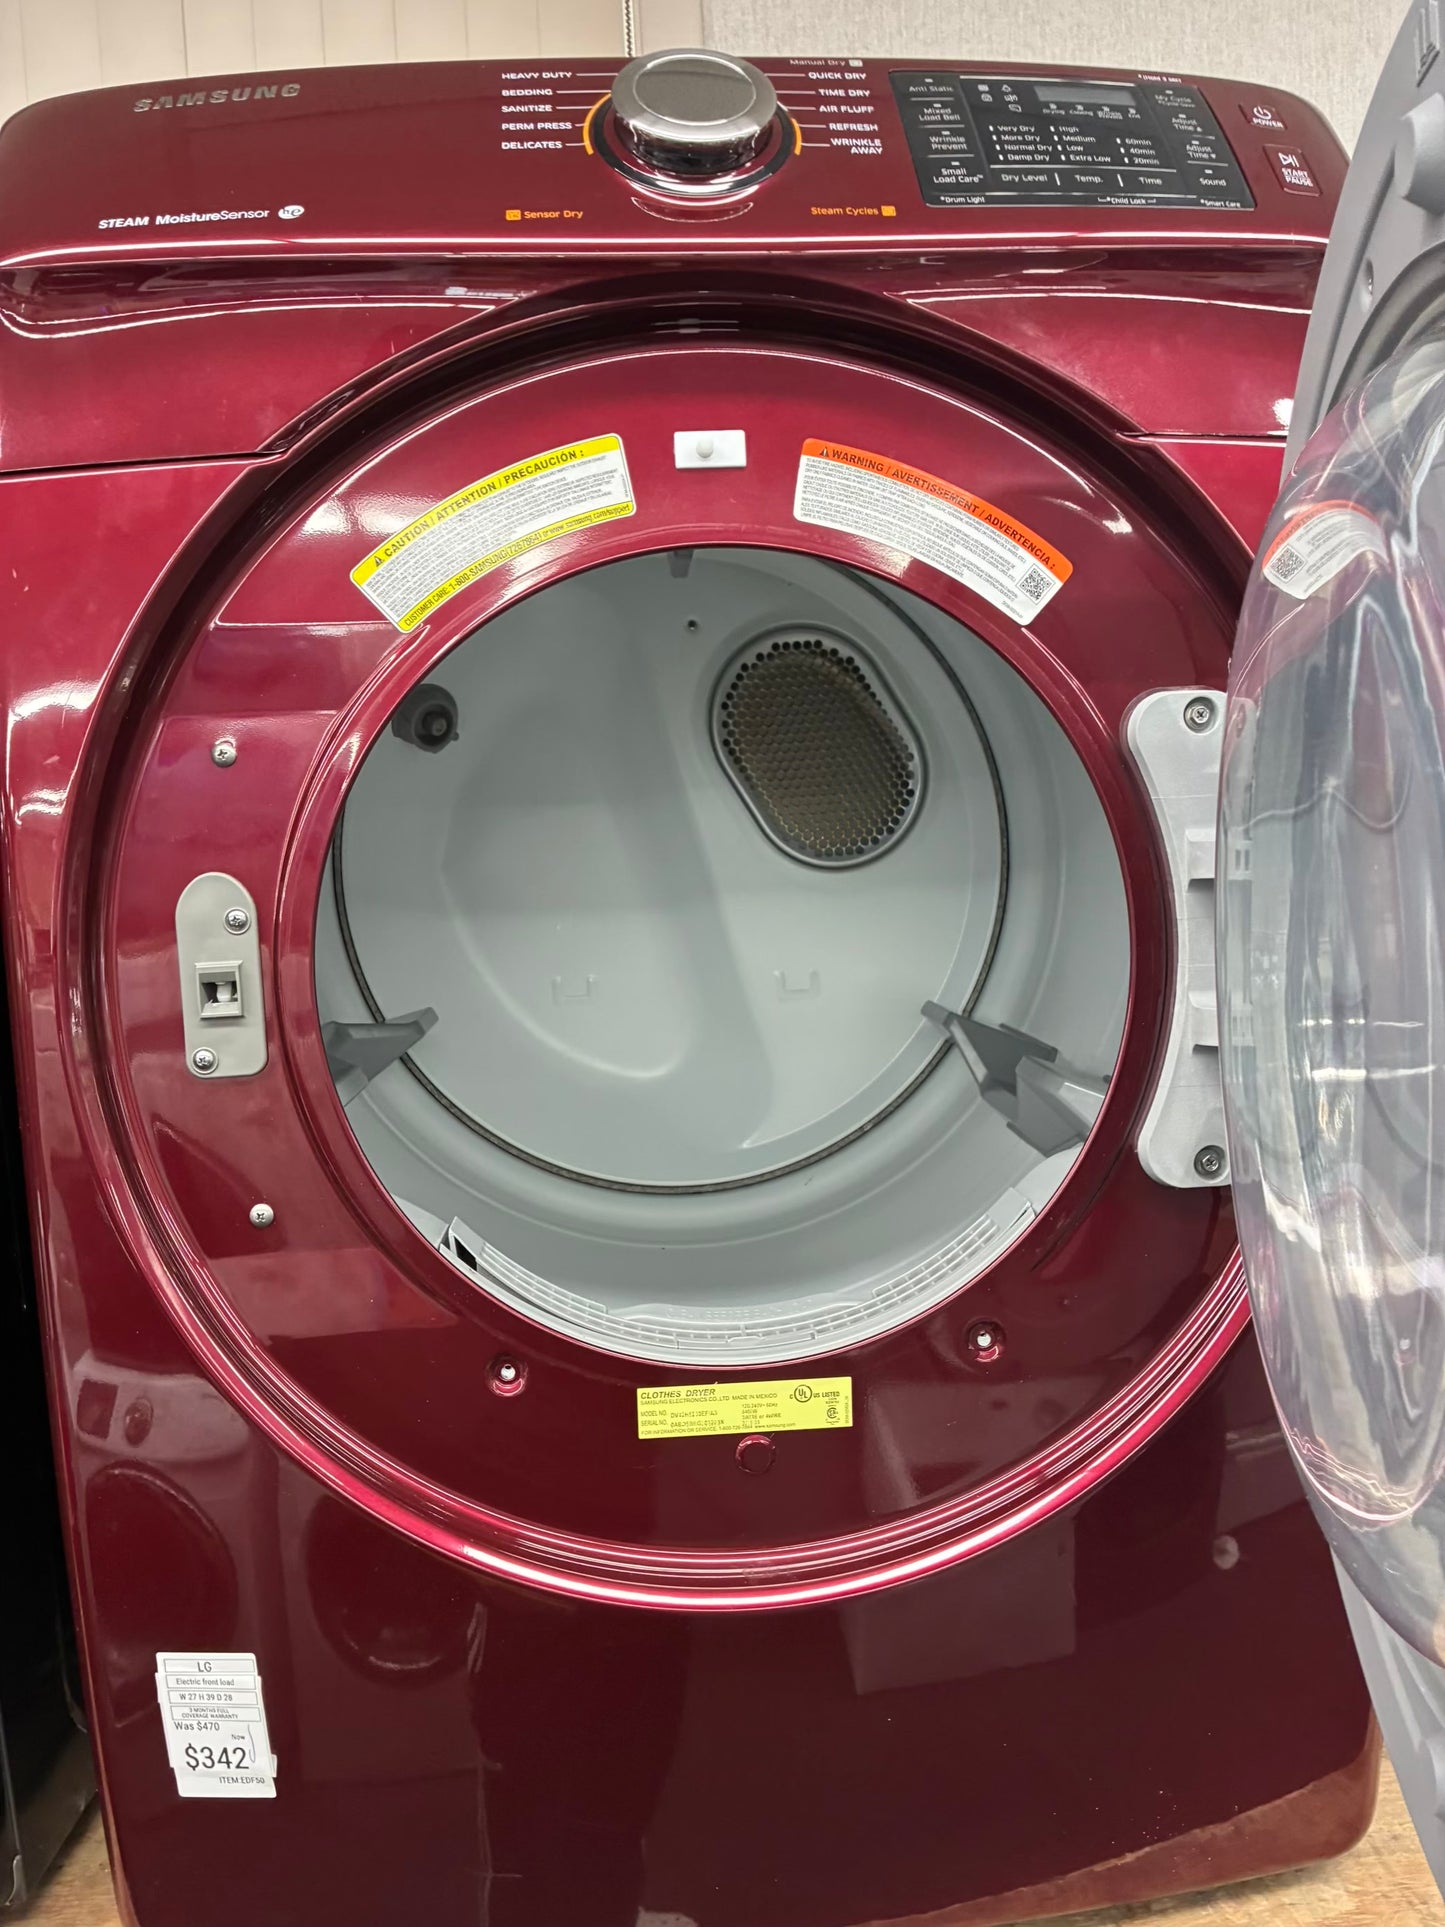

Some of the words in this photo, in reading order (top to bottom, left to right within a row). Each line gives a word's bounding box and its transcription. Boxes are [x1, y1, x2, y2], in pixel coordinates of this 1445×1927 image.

[808, 72, 842, 80] QUICK
[502, 88, 553, 96] BEDDING
[818, 88, 846, 96] TIME
[848, 89, 870, 98] DRY
[134, 83, 300, 112] SAMSUNG
[502, 104, 553, 112] SANITIZE
[840, 105, 874, 114] FLUFF
[502, 122, 534, 130] PERM
[828, 123, 878, 132] REFRESH
[1252, 118, 1284, 128] POWER
[502, 141, 562, 150] DELICATES
[830, 138, 882, 146] WRINKLE
[850, 146, 883, 154] AWAY
[1130, 148, 1156, 156] 40min
[1186, 144, 1212, 152] Adjust
[1034, 154, 1050, 162] Dry
[1133, 157, 1160, 165] 20min
[1282, 168, 1308, 178] START
[1002, 174, 1019, 182] Dry
[1022, 174, 1048, 182] Level
[1074, 174, 1104, 184] Temp.
[1138, 176, 1162, 185] Time
[1200, 178, 1226, 186] Sound
[1286, 176, 1314, 187] PAUSE
[967, 196, 986, 204] Light
[524, 211, 560, 219] Sensor
[564, 210, 583, 219] Dry
[810, 206, 843, 216] Steam
[847, 207, 878, 217] Cycles
[98, 216, 150, 229] STEAM
[156, 210, 270, 226] MoistureSensor
[384, 519, 430, 557] CAUTION
[437, 481, 496, 522] ATTENTION
[504, 450, 578, 484] PRECAUCIÓN
[832, 449, 884, 472] WARNING
[892, 468, 980, 514] AVERTISSEMENT
[985, 513, 1050, 566] ADVERTENCIA
[404, 598, 434, 627] CUSTOMER
[640, 1391, 681, 1400] CLOTHES
[686, 1388, 716, 1397] DRYER
[196, 1661, 212, 1673] LG
[176, 1678, 200, 1686] Electric
[174, 1721, 194, 1730] Was
[196, 1720, 220, 1732] $470
[185, 1742, 250, 1772] $342
